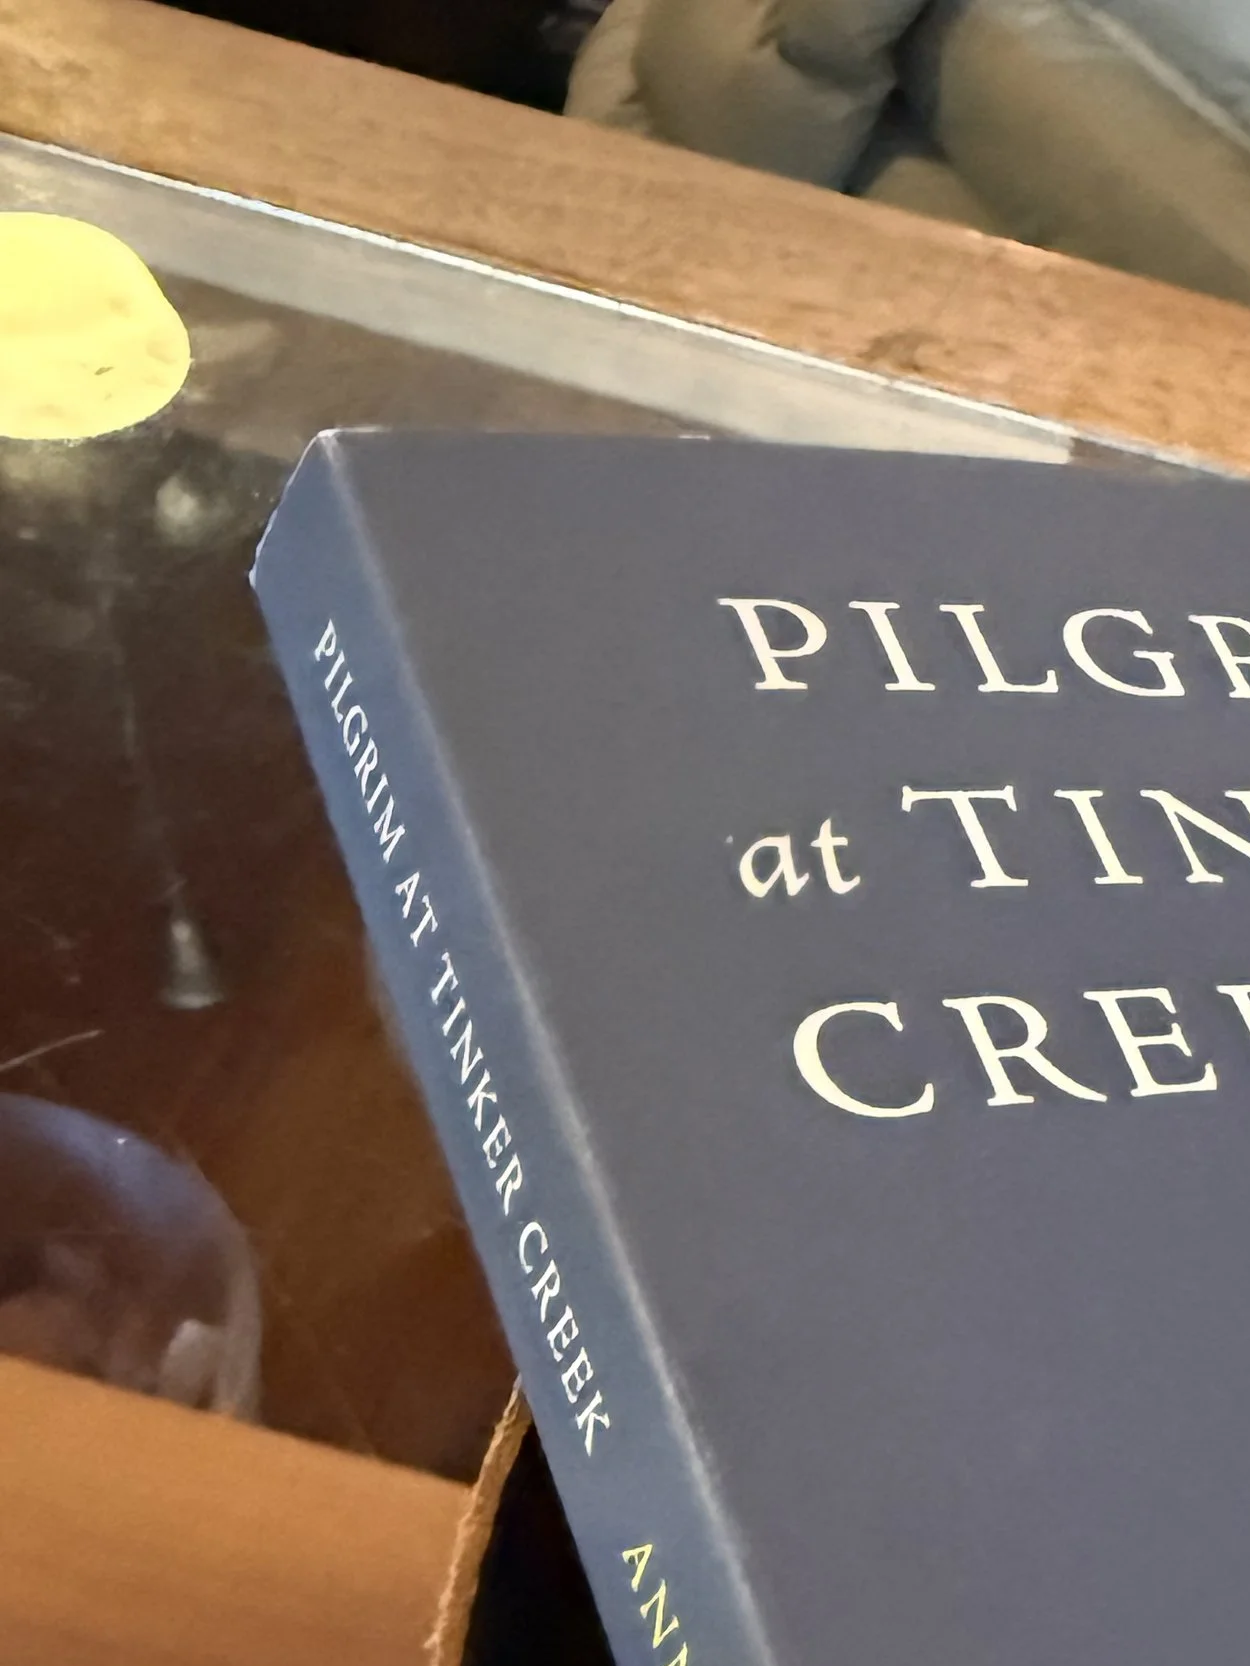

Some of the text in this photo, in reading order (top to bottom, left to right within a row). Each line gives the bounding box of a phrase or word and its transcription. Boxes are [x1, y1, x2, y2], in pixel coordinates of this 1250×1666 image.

[314, 618, 612, 1458] PILGRIM AT TINKER CREEK
[737, 818, 862, 898] at
